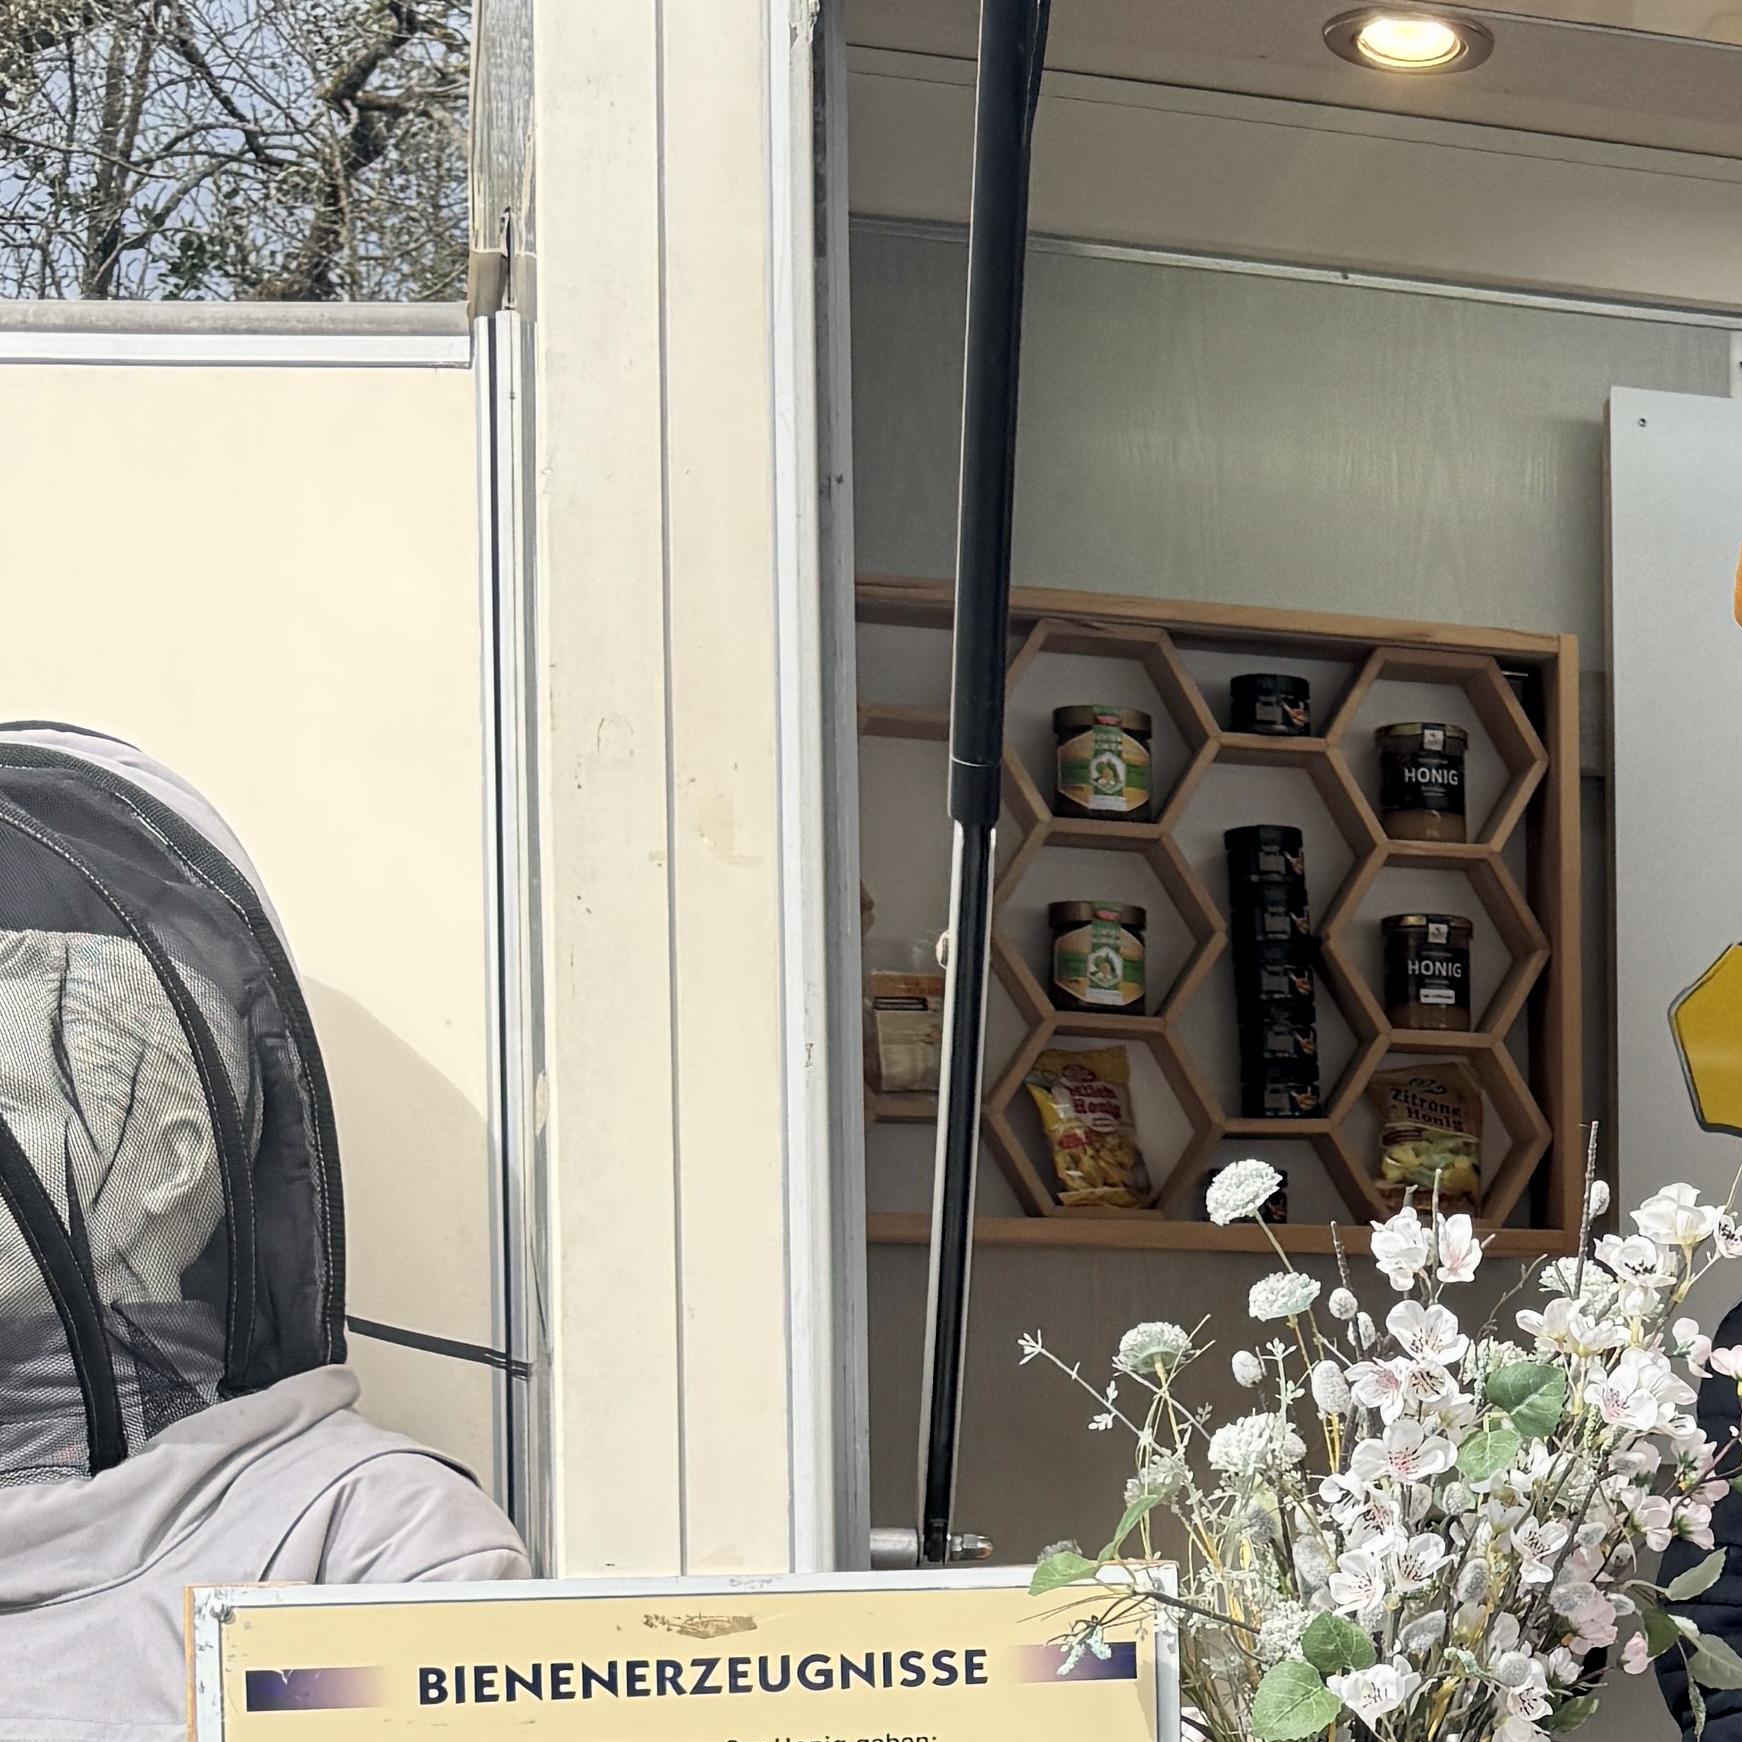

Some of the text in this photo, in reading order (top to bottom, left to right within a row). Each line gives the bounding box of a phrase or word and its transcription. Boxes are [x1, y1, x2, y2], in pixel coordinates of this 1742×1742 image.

[1403, 766, 1459, 786] HONIG
[1406, 959, 1462, 979] HONIG
[418, 1648, 989, 1706] BIENENERZEUGNISSE
